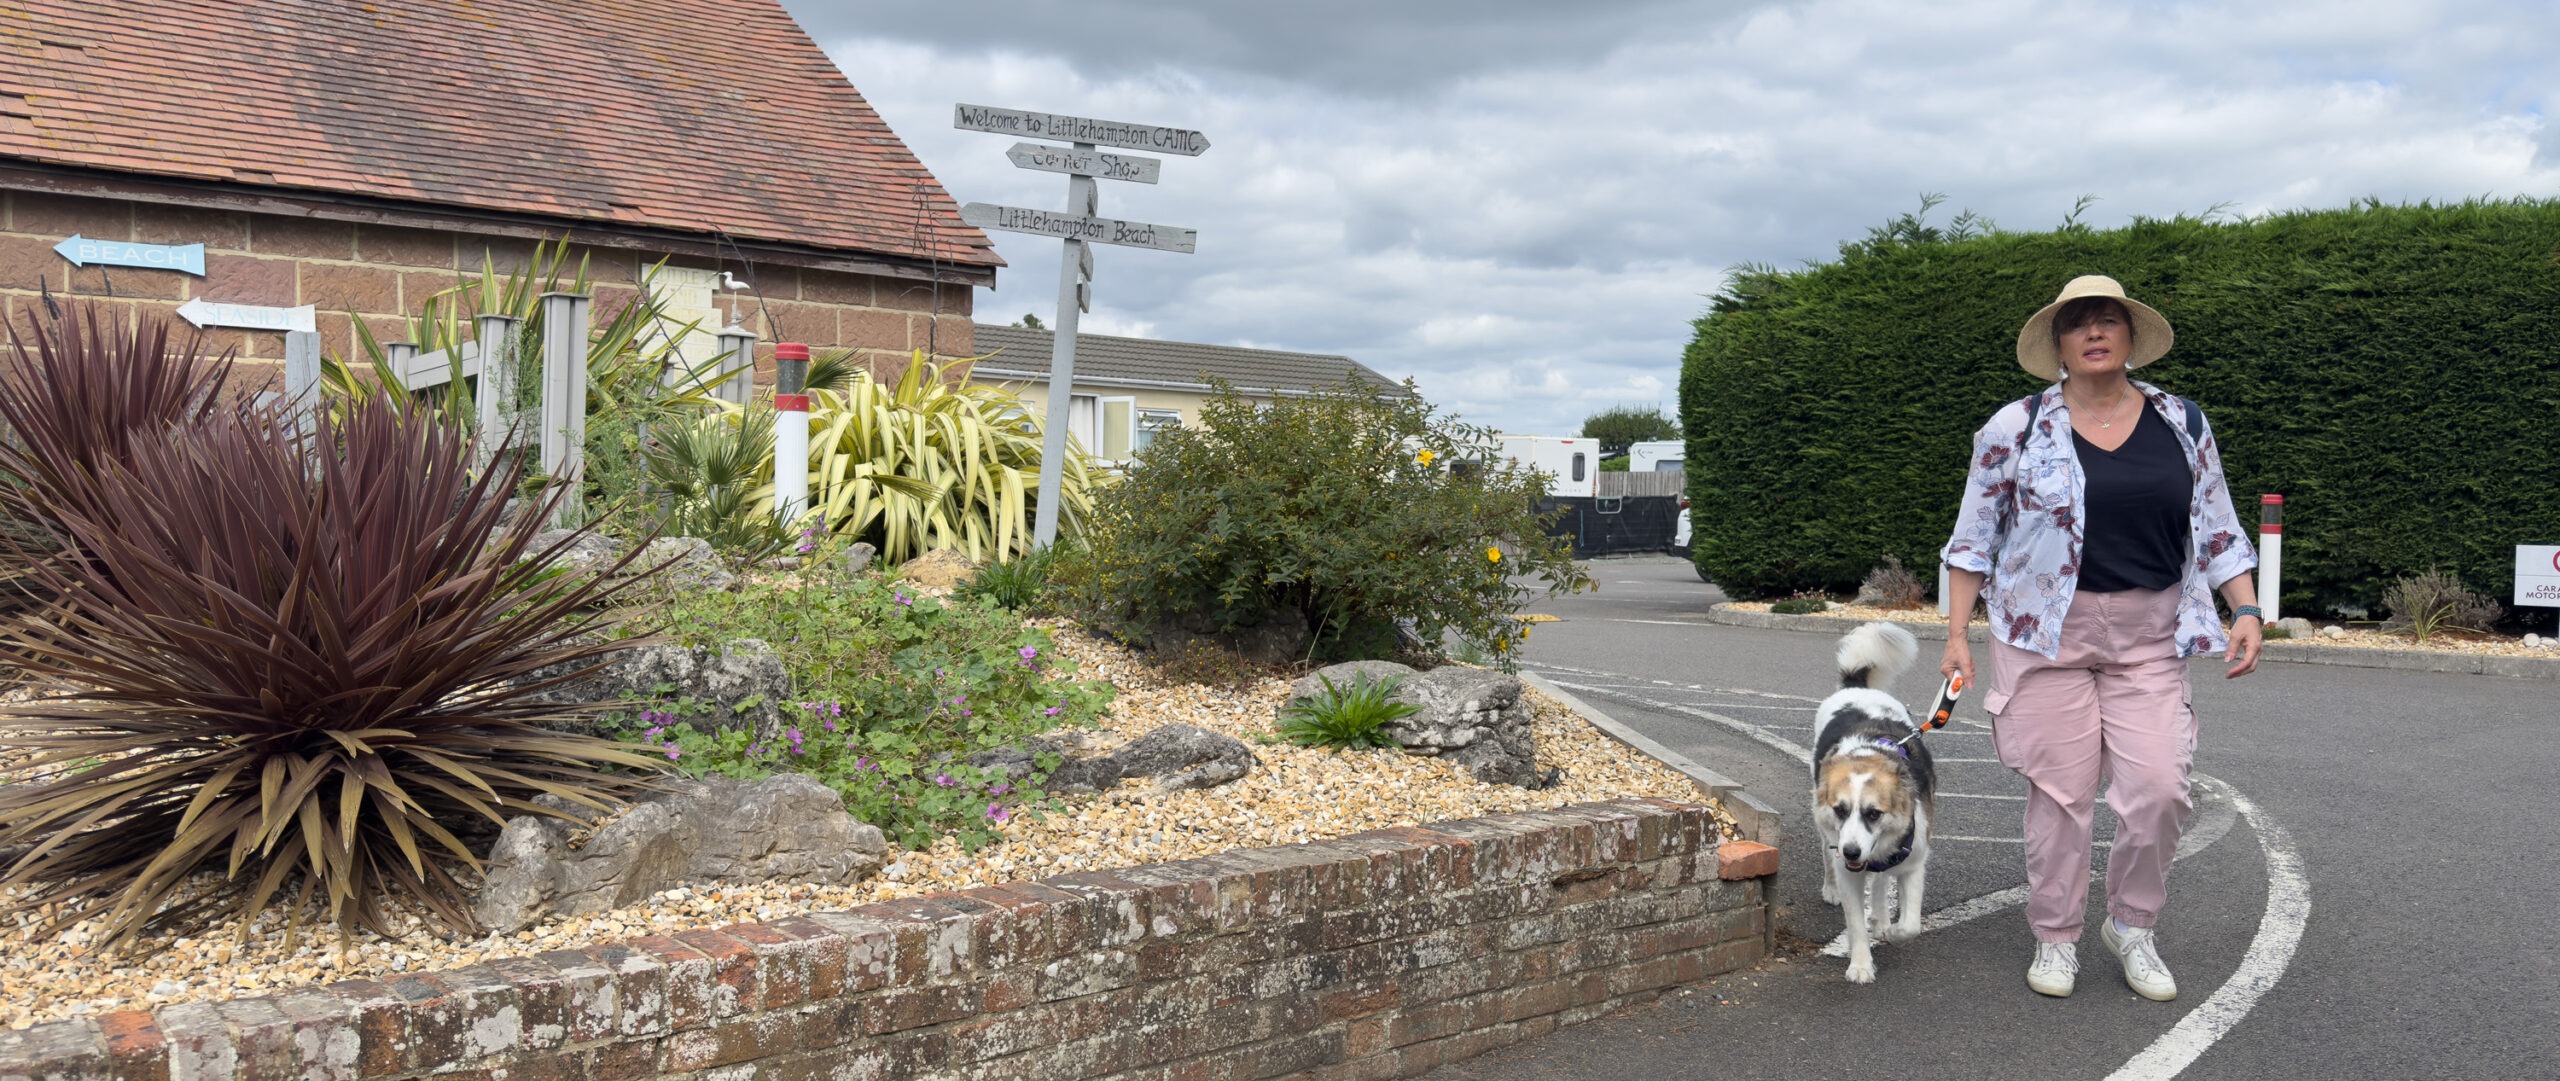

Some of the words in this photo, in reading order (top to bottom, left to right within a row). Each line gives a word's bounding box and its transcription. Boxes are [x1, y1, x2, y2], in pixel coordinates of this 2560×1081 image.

[960, 107, 1019, 130] Welcome
[1025, 114, 1042, 133] to
[1047, 115, 1149, 147] Littlehampton
[1152, 126, 1200, 152] CAMC
[998, 206, 1105, 240] Littlehampton
[1113, 219, 1157, 246] Beach
[79, 243, 188, 267] BEACH
